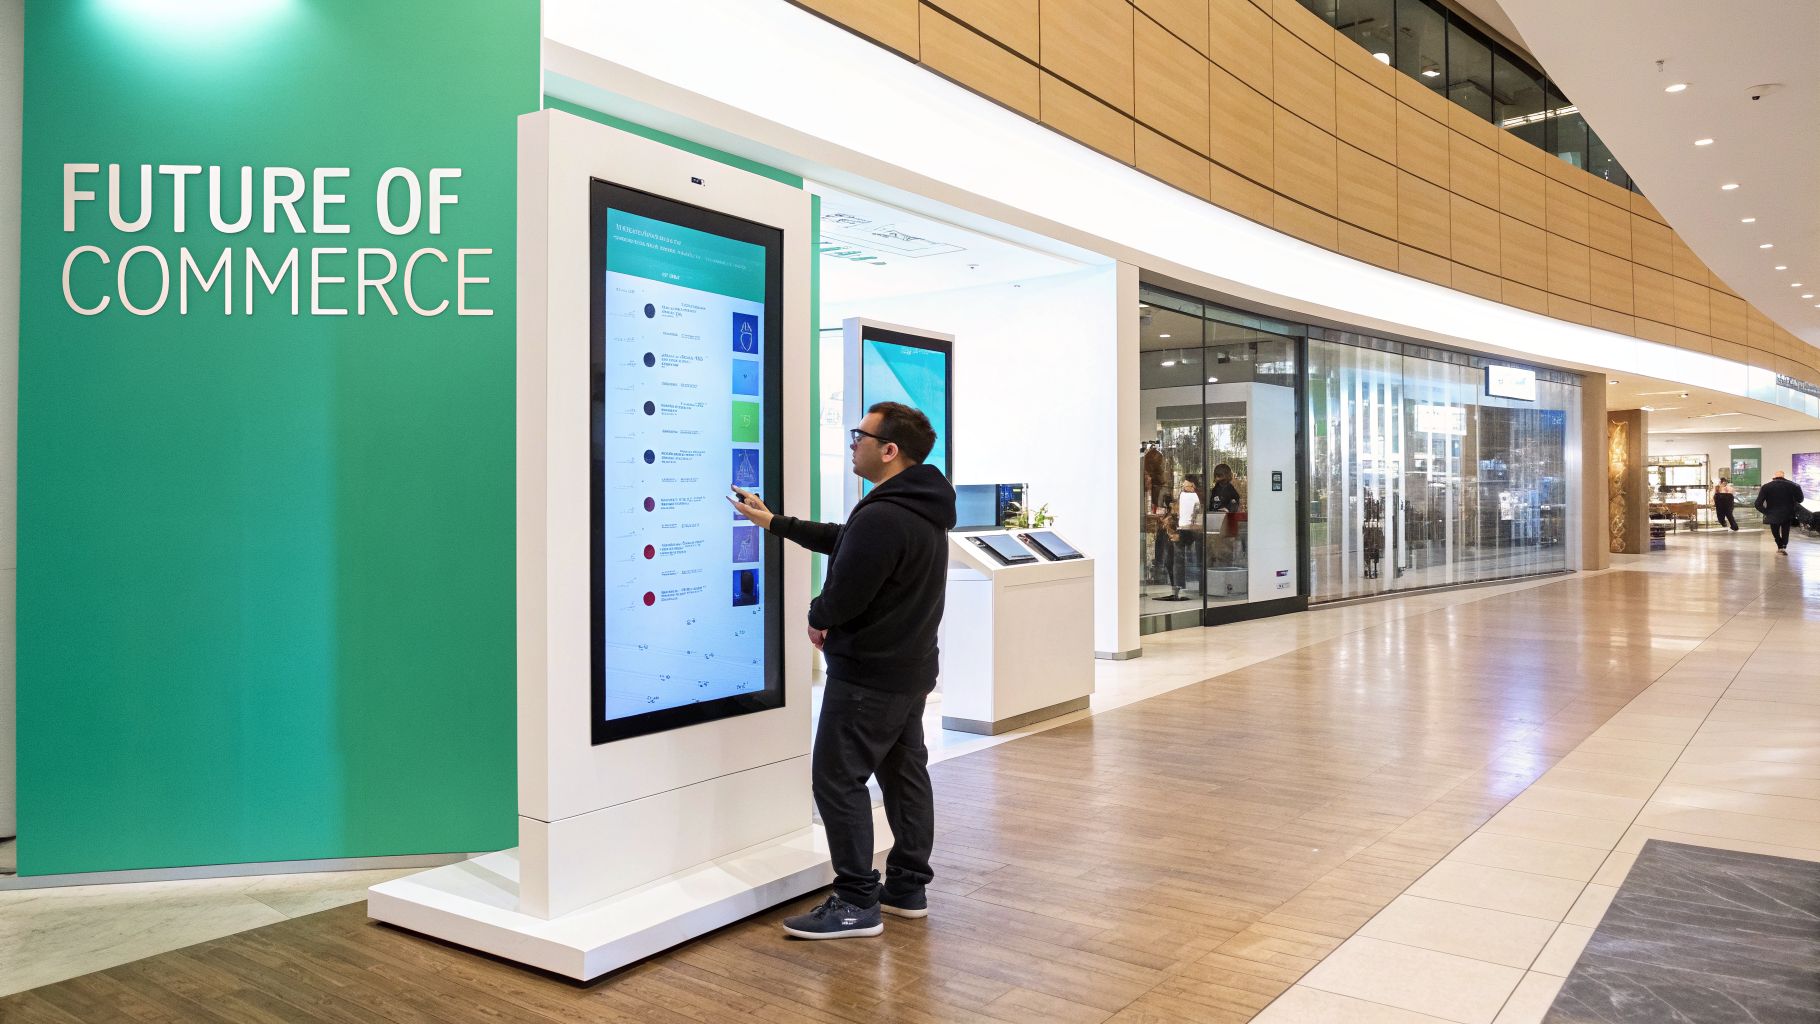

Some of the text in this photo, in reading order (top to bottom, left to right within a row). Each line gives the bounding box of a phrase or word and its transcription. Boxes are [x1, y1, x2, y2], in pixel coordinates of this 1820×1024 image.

[63, 163, 462, 235] FUTURE OF
[62, 245, 494, 317] COMMERCE
